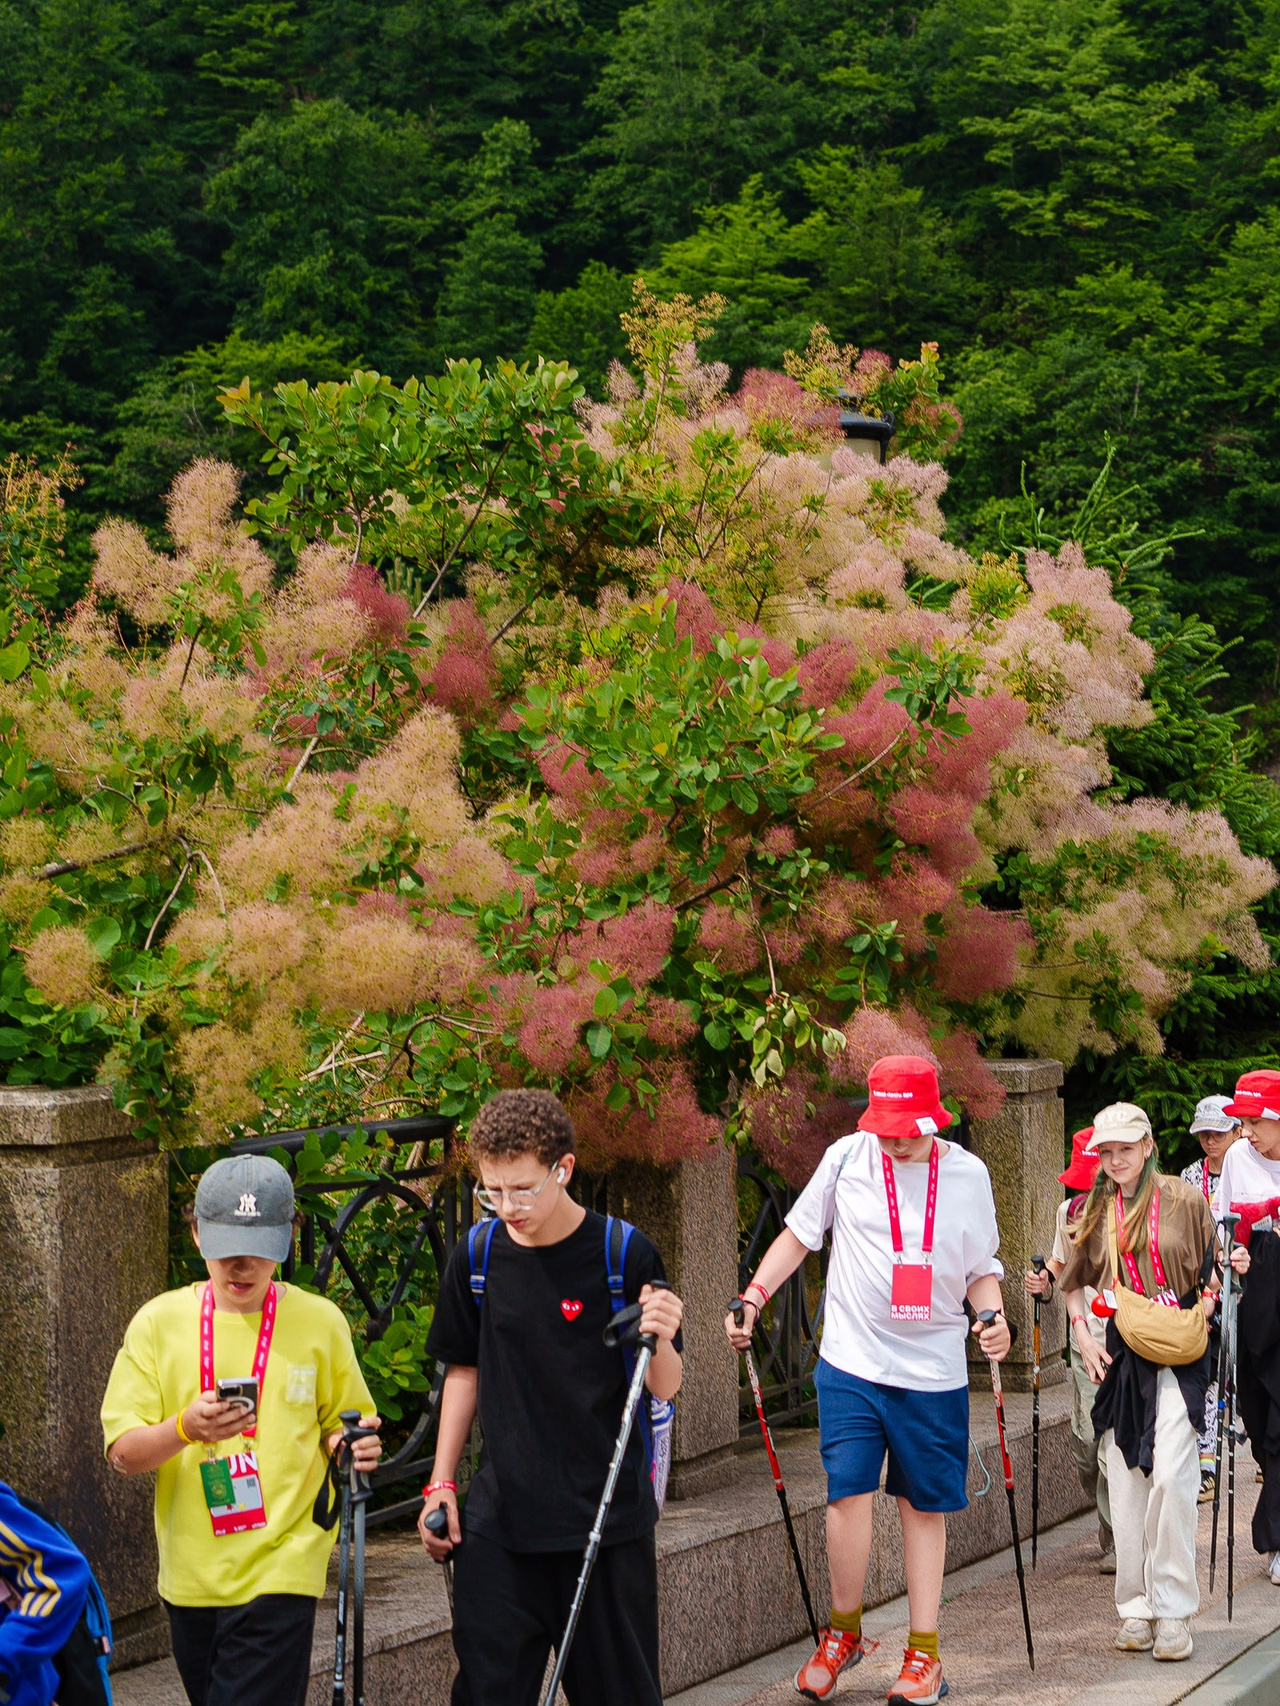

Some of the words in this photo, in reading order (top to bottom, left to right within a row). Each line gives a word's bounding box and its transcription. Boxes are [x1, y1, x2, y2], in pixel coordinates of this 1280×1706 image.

[1149, 1288, 1178, 1306] UN
[898, 1304, 930, 1314] СВОИХ
[890, 1312, 930, 1321] МЫСЛЯХ
[229, 1450, 259, 1476] UN
